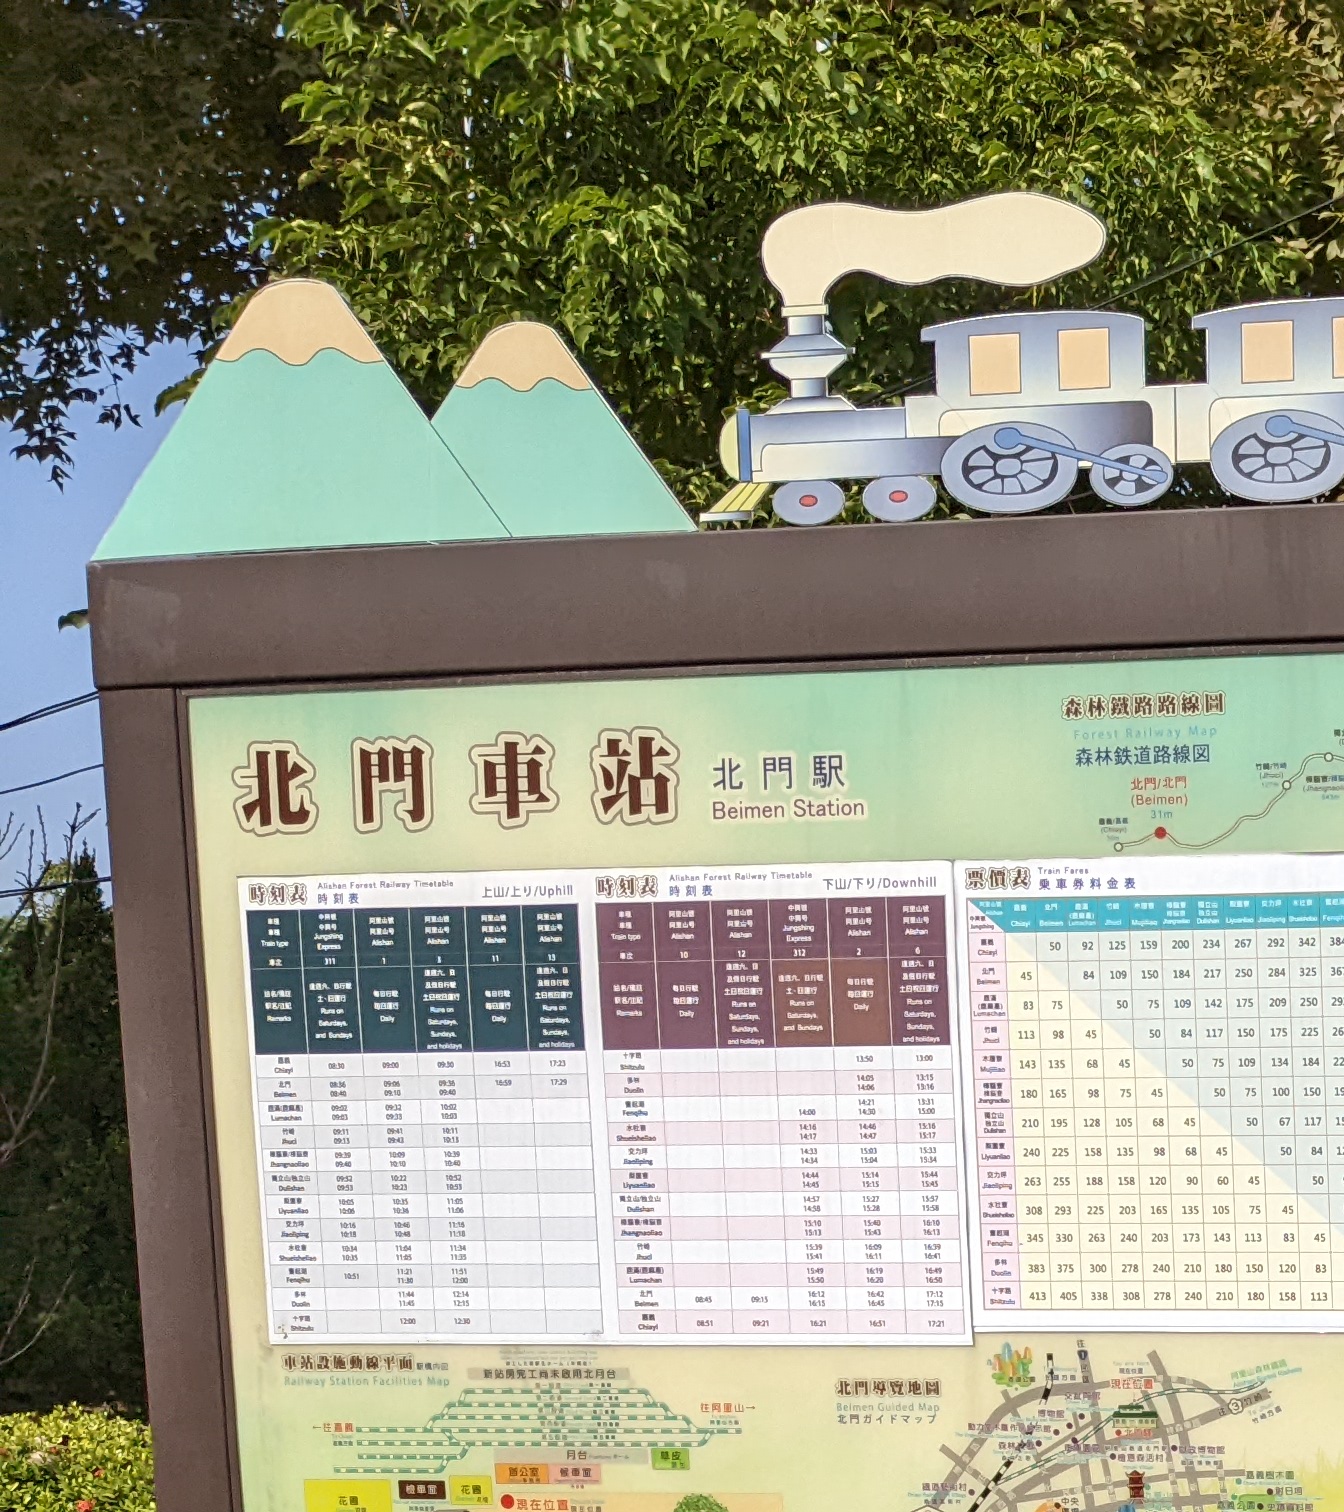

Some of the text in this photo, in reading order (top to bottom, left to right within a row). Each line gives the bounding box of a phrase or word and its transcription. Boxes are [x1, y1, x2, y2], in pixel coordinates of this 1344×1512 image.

[1062, 690, 1226, 720] 森林鐵路路線圖
[1073, 724, 1217, 741] Forest Railway Map
[1075, 744, 1211, 767] 森林鉄道路線図
[712, 754, 845, 790] 北門駅
[236, 731, 678, 833] 北門車站
[713, 798, 864, 819] Beimen Station
[1151, 808, 1173, 820] 31m
[703, 873, 731, 881] Forest
[734, 872, 767, 881] Railway
[771, 871, 812, 880] Timetable
[965, 867, 1031, 890] 票價表
[1038, 867, 1060, 875] Train
[482, 885, 573, 899] 上山/上り/Uphill
[595, 874, 658, 897] 時刻表
[823, 877, 937, 890] 下山/下り/Downhill
[249, 883, 307, 905] 時刻表
[284, 1375, 449, 1388] Railway Station Facilities Map
[835, 1378, 942, 1397] 北門導覽地圖
[878, 1402, 915, 1412] Guided
[918, 1402, 939, 1414] Map
[837, 1414, 936, 1425] 北門ガイドマップ
